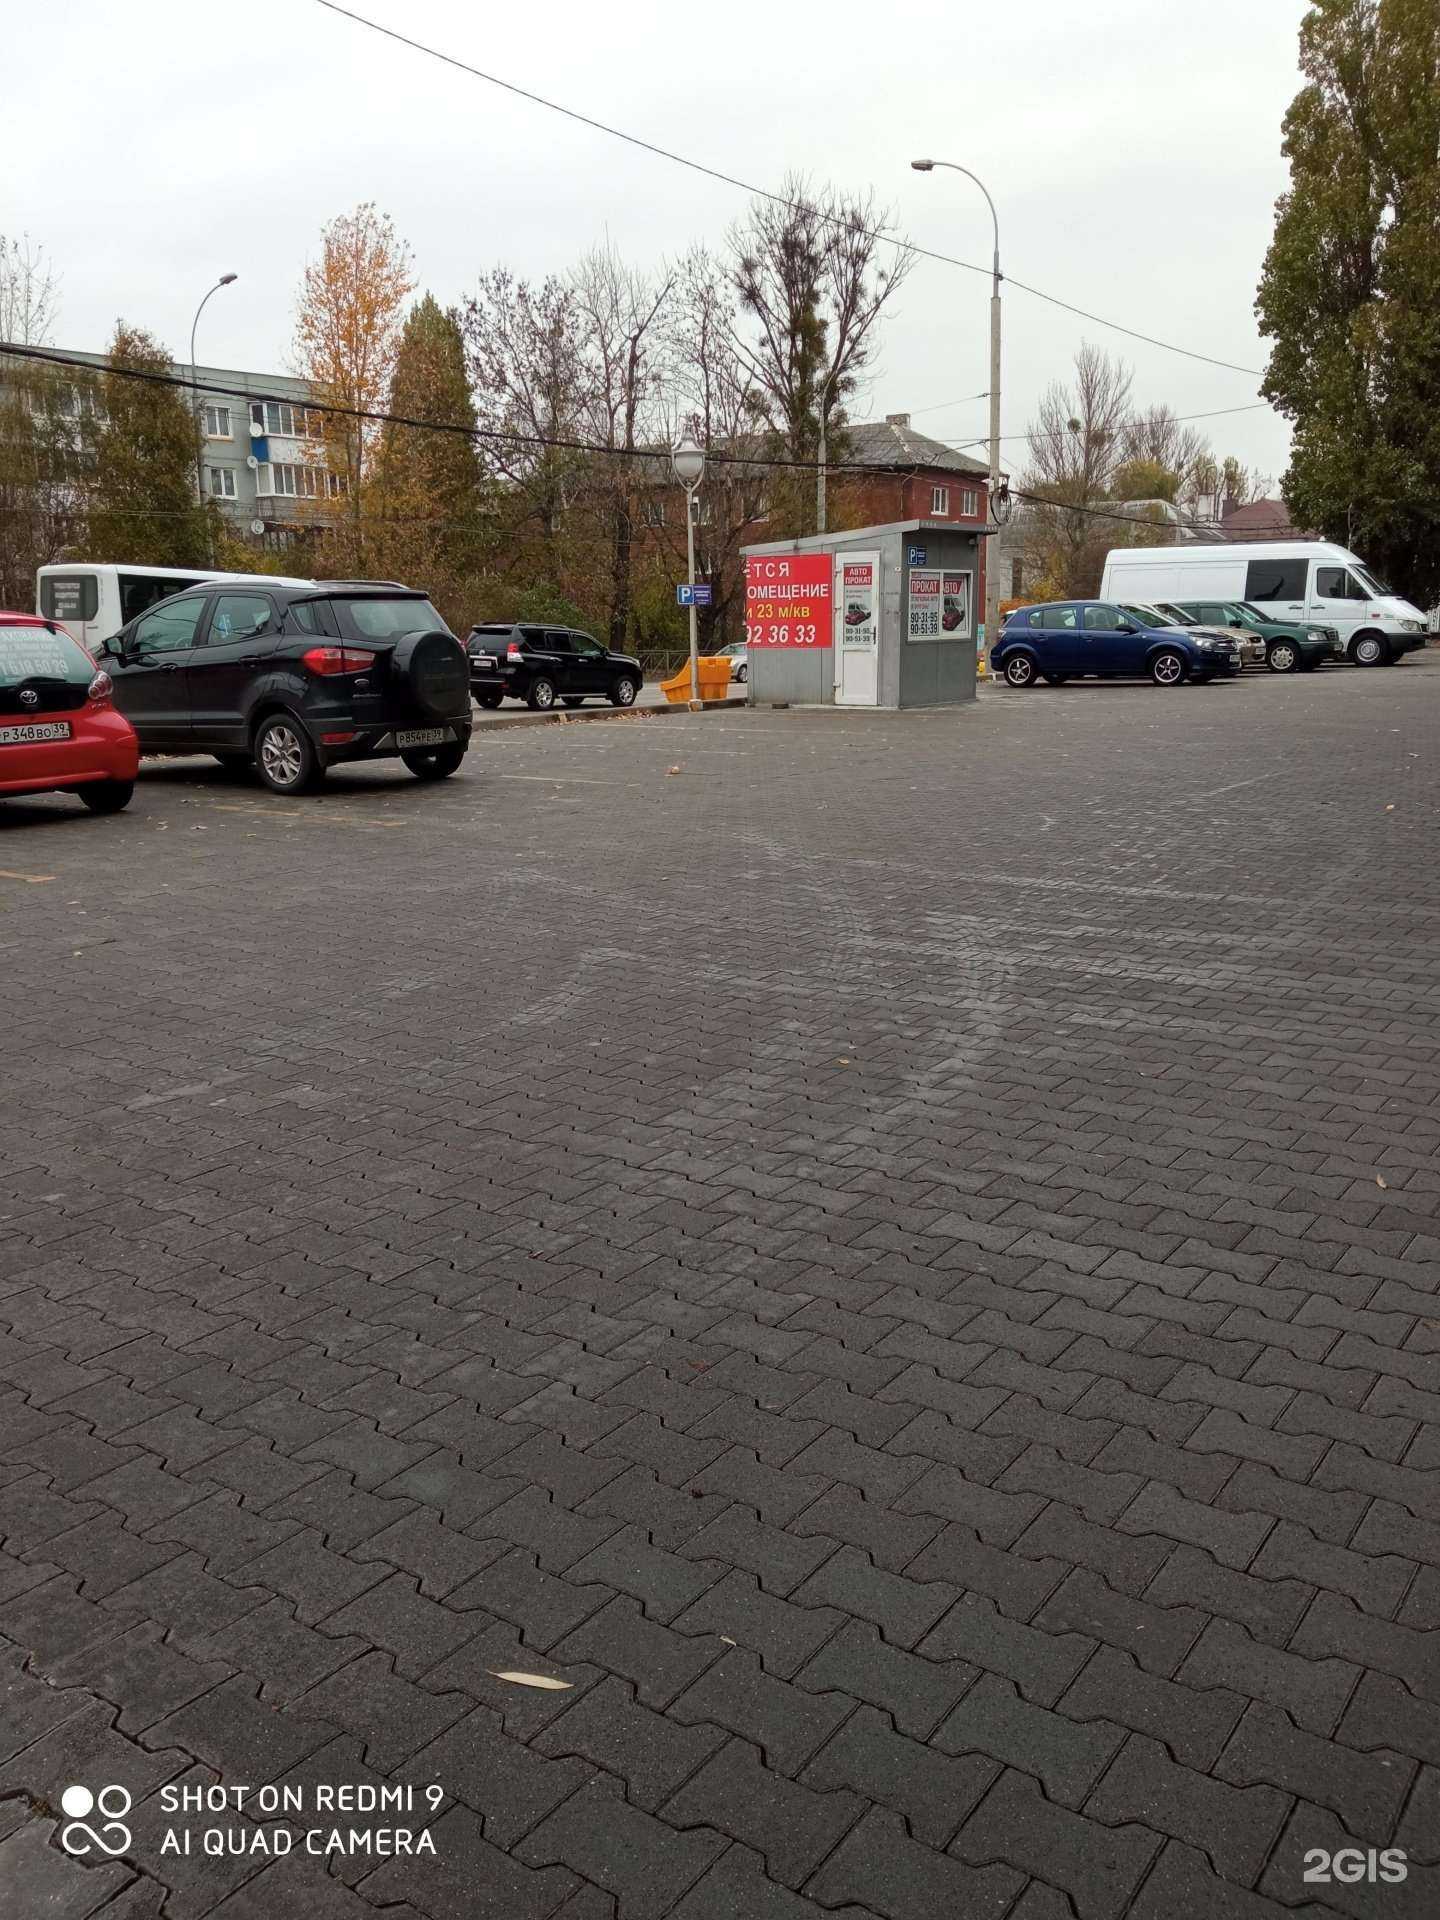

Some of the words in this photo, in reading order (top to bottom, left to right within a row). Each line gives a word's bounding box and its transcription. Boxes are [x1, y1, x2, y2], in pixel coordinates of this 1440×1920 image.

[849, 567, 868, 576] АВТО
[846, 577, 871, 587] ПРОКАТ
[911, 580, 937, 593] ПРОКАТ
[681, 587, 691, 603] P
[747, 583, 829, 601] ОМЕЩЕНИЕ
[757, 603, 773, 618] 23
[778, 602, 810, 618] м/кв
[768, 624, 789, 644] 36
[795, 624, 816, 644] 33
[910, 623, 938, 635] 90-51-39
